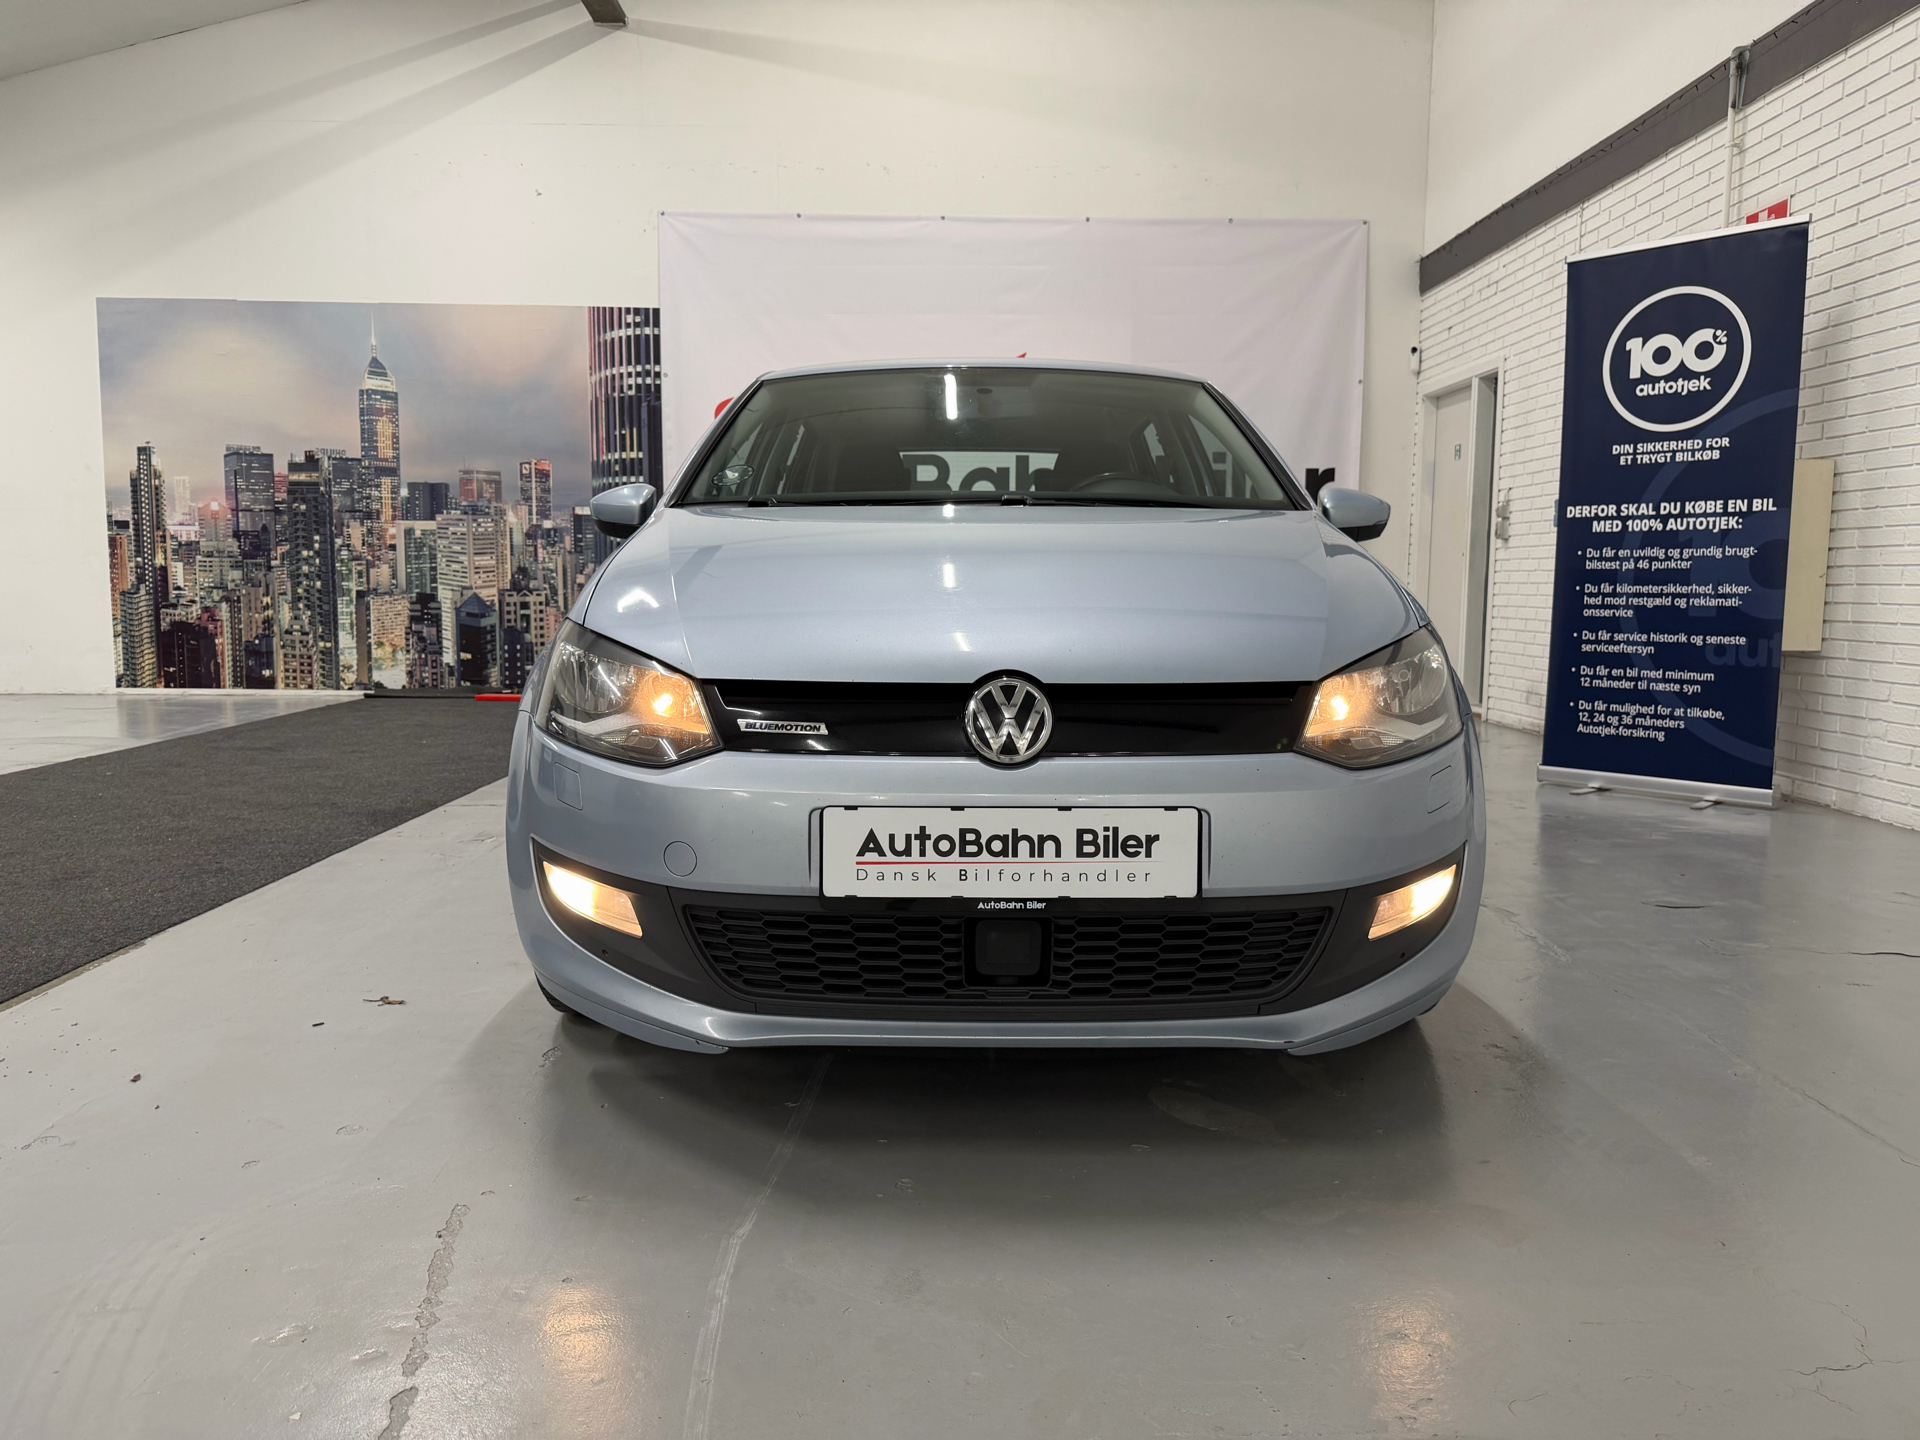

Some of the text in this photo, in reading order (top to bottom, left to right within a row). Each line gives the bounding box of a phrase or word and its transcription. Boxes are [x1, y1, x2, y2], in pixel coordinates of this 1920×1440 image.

[1635, 374, 1711, 396] autotjek
[1612, 437, 1730, 454] DIN SIKKERHED FOR
[1620, 450, 1720, 465] ET TRYGT BILKØB
[1567, 498, 1777, 518] DERFOR SKAL DU KØBE EN BIL
[1592, 516, 1742, 533] MED 100% AUTOTJEK:
[1587, 546, 1757, 559] Du får en uvildig og grundig brugt-
[1586, 558, 1692, 571] bilstest på 46 punkter
[1585, 583, 1751, 595] Du får kilometersikkerhed, sikker-
[1584, 595, 1742, 608] hed mod restgæld og reklamati-
[1583, 607, 1633, 617] onsservice
[1582, 630, 1746, 646] Du får service historik og seneste
[1582, 643, 1654, 656] serviceeftersyn
[1581, 666, 1593, 675] Du
[1596, 665, 1609, 675] får
[1627, 667, 1638, 677] bil
[1641, 669, 1662, 678] med
[1666, 670, 1714, 681] minimum
[1580, 677, 1700, 695] 12 måneder til næste syn
[1579, 700, 1724, 720] Du får mulighed for at tilkøbe,
[744, 722, 821, 733] BLUEMOTION
[1579, 712, 1684, 728] 12, 24 og 36 måneders
[1577, 723, 1666, 741] Autotjek-forsikring
[855, 825, 1160, 858] AutoBahn Biler
[856, 868, 1151, 883] Dansk Bilforhandler
[977, 901, 1047, 909] AutoBahn Biler
